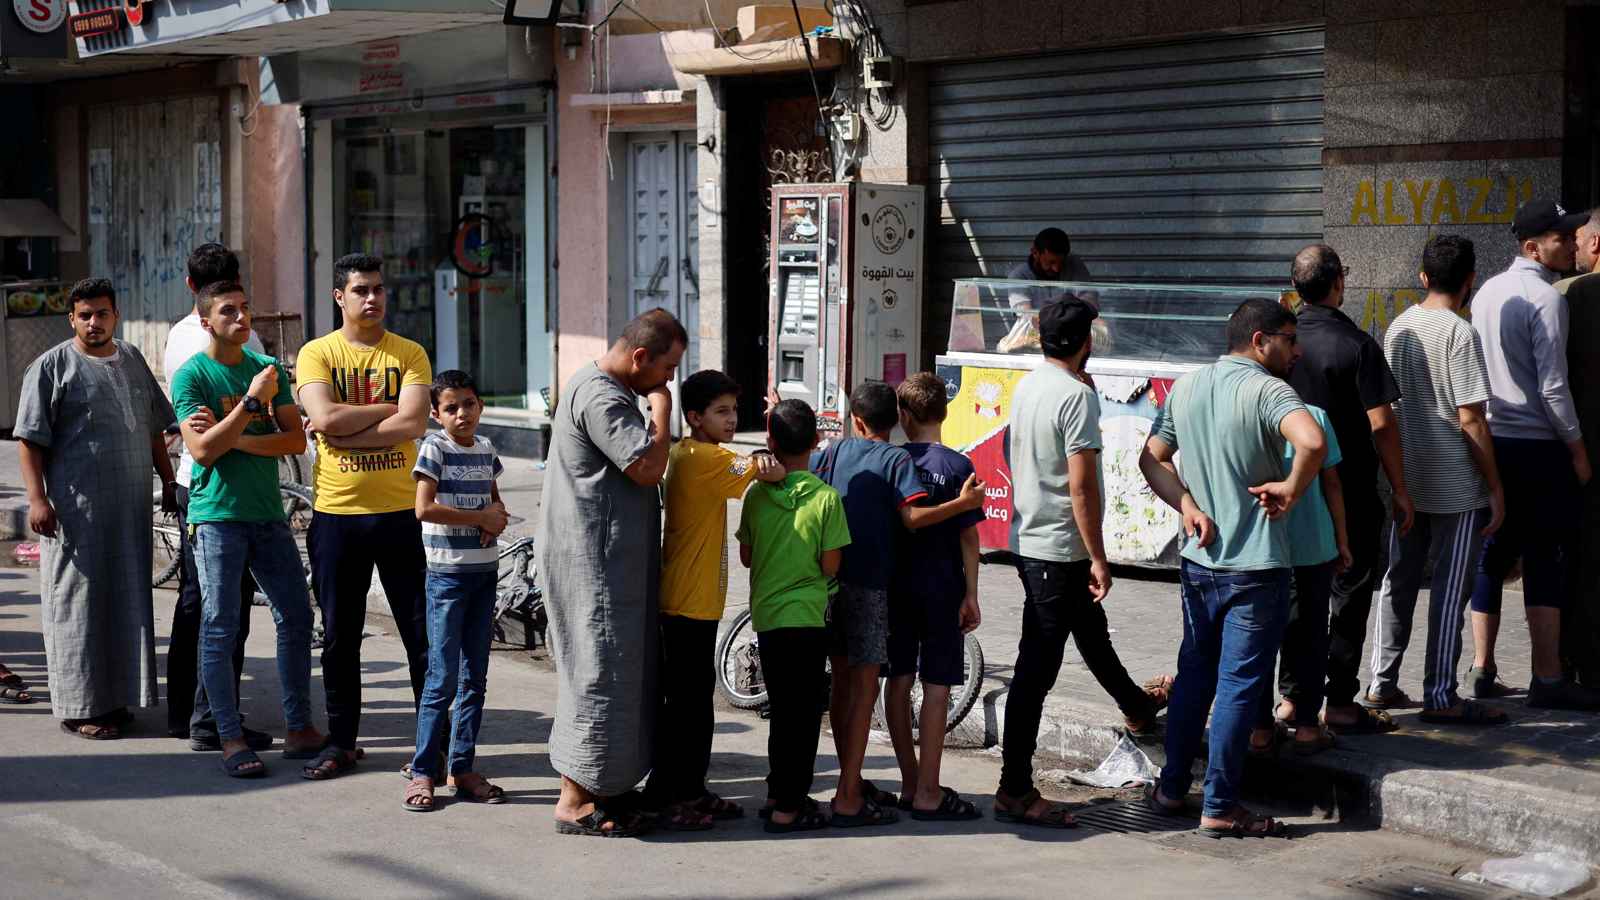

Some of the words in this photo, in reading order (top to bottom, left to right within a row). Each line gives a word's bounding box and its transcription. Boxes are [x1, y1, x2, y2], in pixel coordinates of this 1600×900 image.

[862, 265, 893, 281] القهوة
[896, 268, 914, 281] بيت
[338, 452, 406, 473] SUMMER
